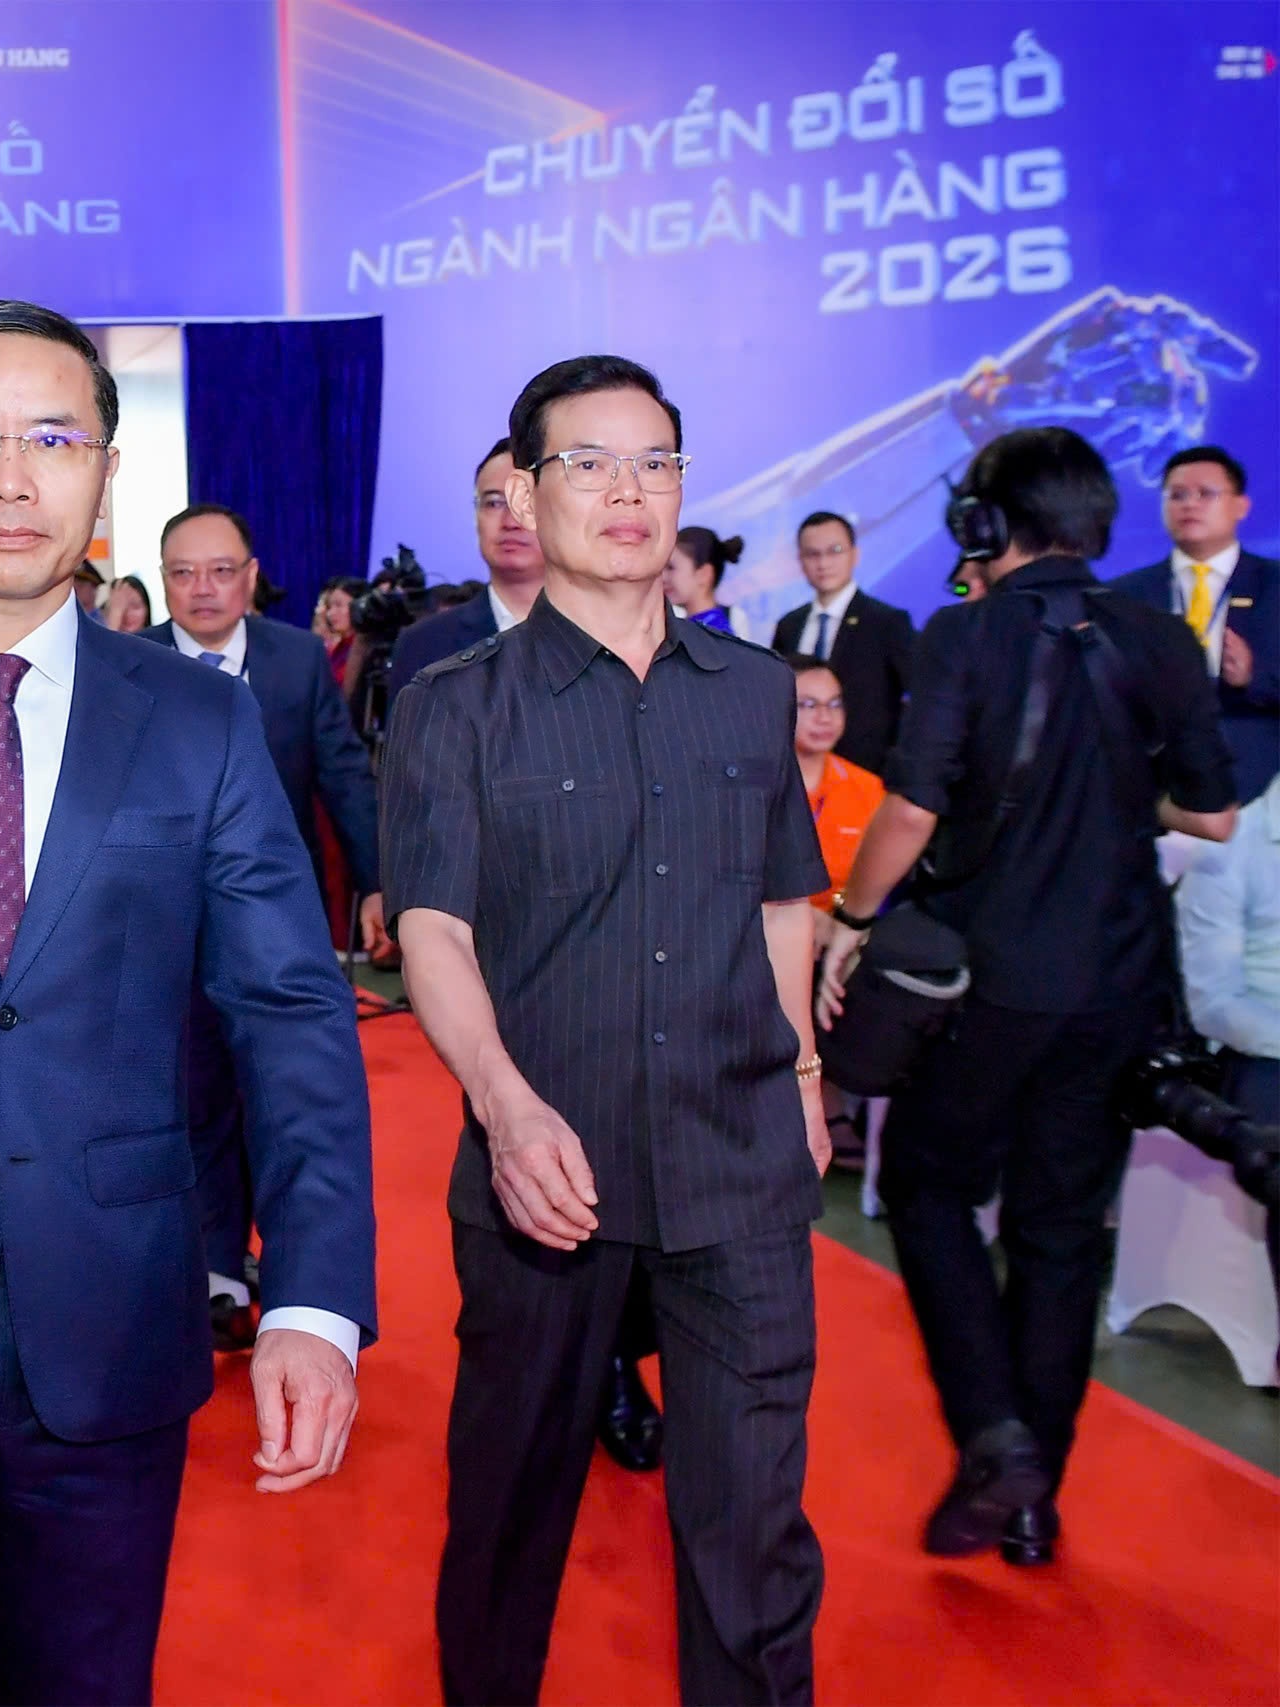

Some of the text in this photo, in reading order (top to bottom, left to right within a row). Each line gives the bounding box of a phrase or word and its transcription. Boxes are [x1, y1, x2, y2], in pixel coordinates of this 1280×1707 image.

[347, 148, 1067, 294] NGÀNH NGÂN HÀNG
[820, 226, 1072, 314] 2026
